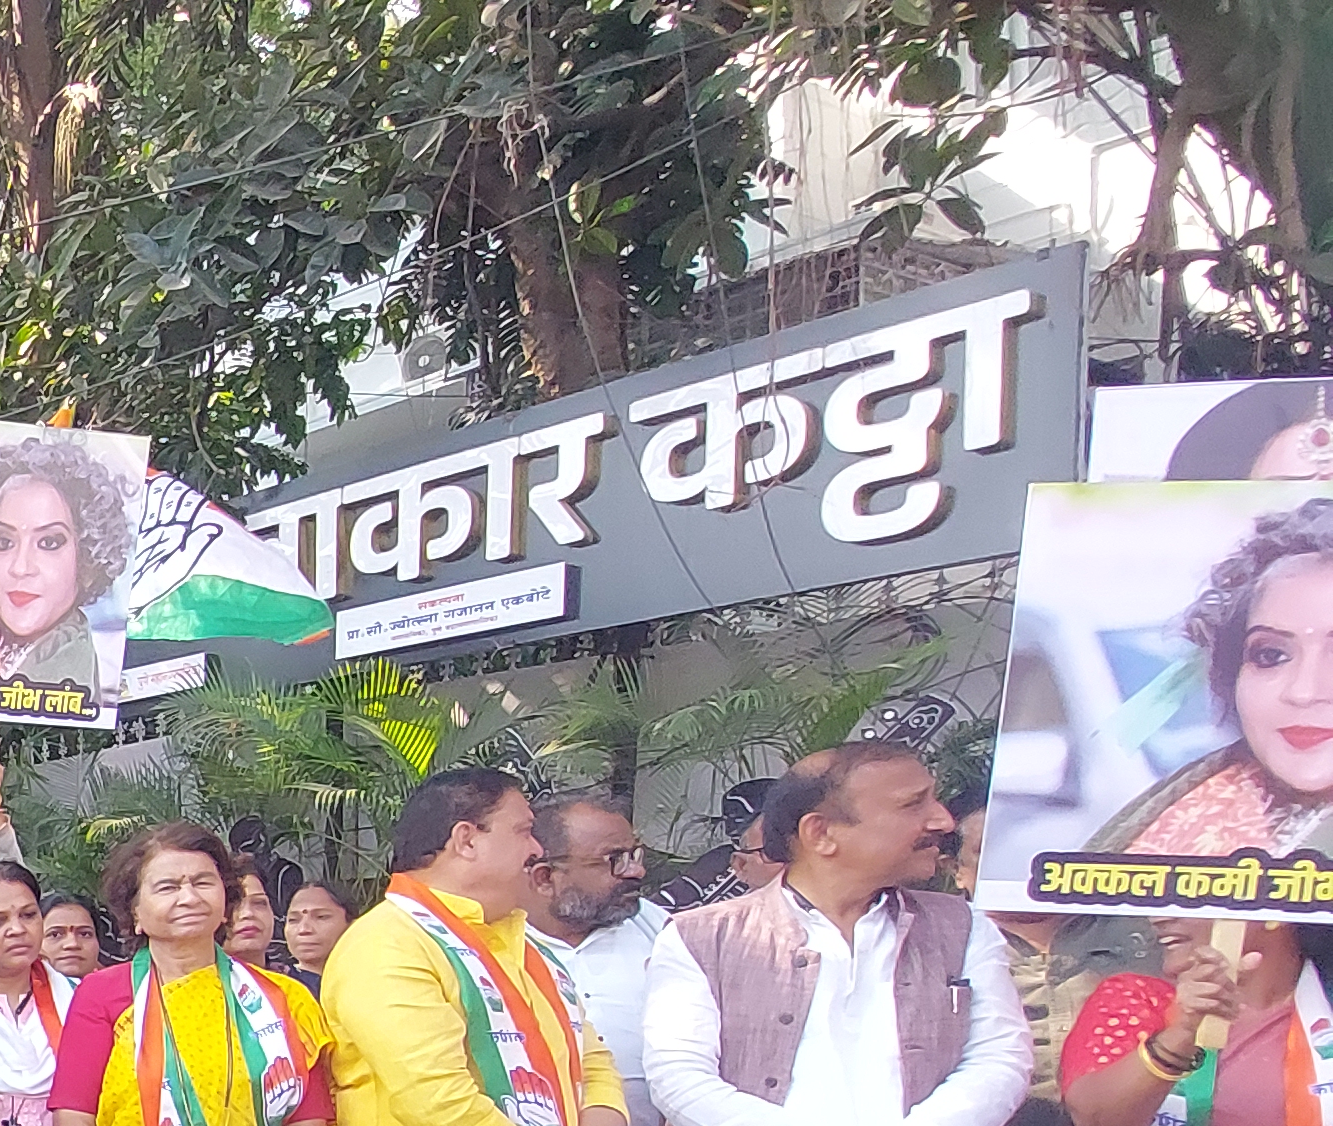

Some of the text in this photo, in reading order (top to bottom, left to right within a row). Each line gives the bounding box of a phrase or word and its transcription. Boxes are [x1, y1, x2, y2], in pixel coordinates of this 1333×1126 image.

[246, 288, 1031, 599] ाकार कट्टा
[444, 601, 496, 619] गजानन
[0, 680, 43, 712] जीभ
[1040, 862, 1171, 897] अक्कल
[1174, 857, 1264, 901] कमी
